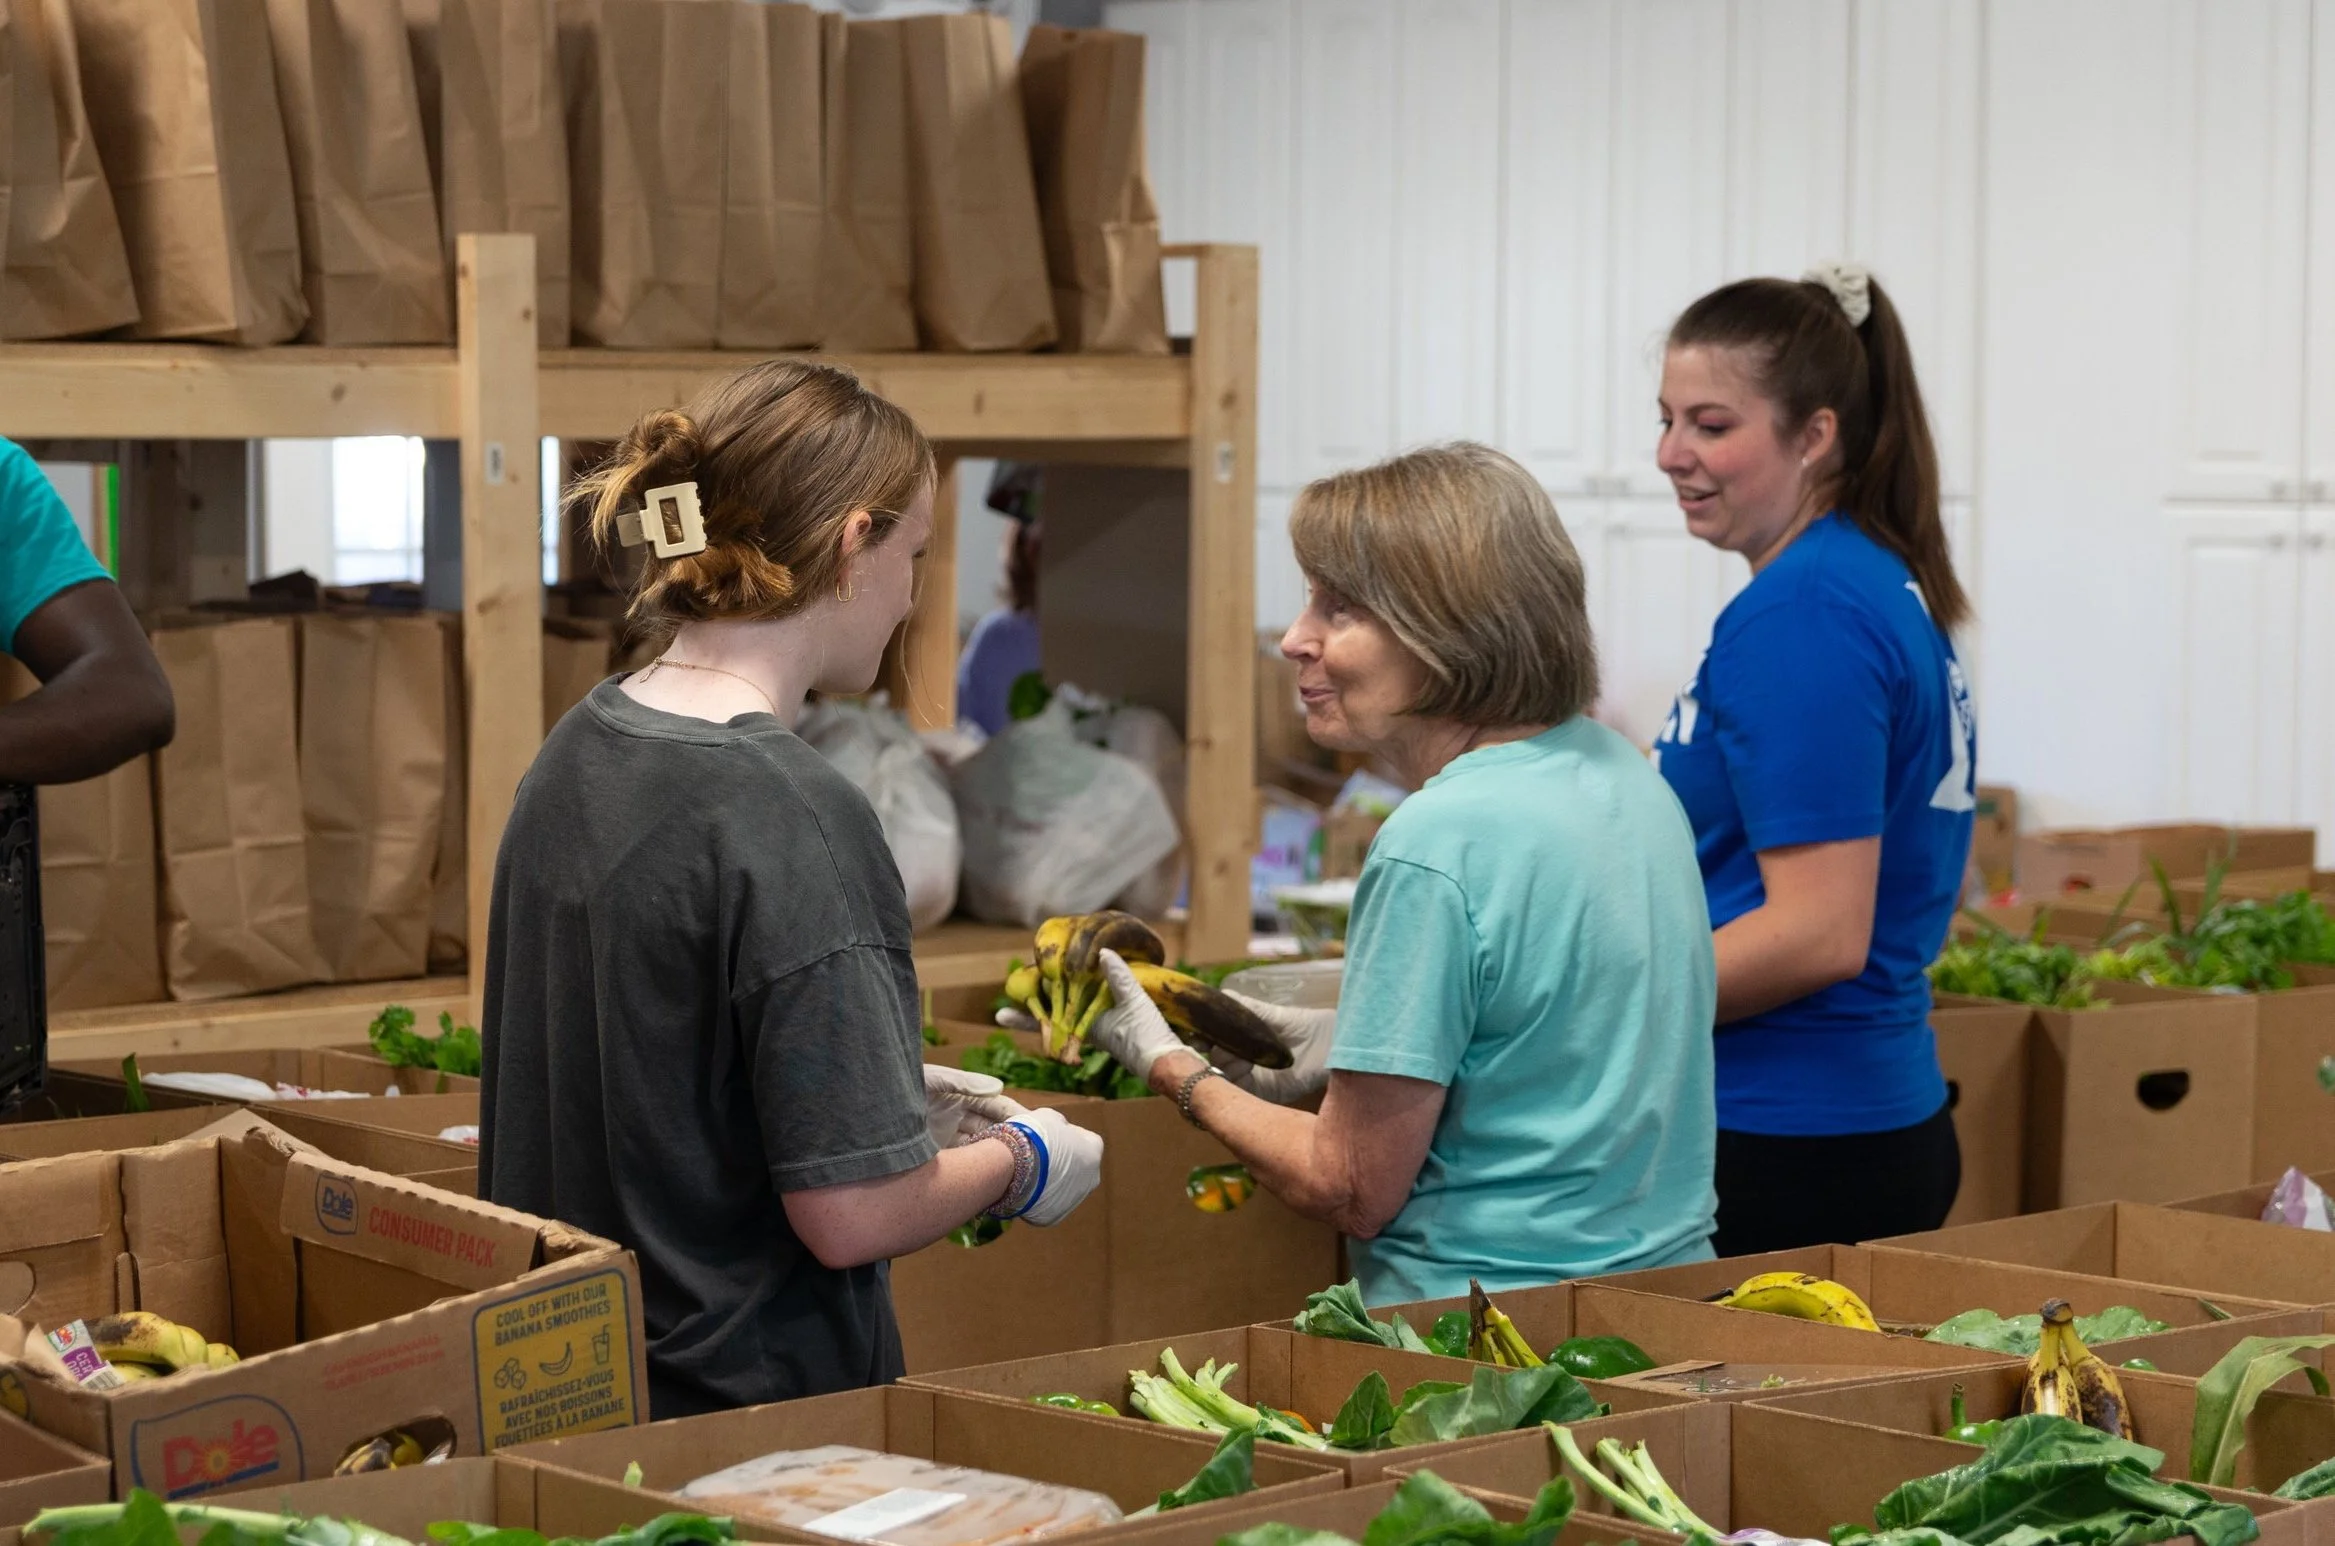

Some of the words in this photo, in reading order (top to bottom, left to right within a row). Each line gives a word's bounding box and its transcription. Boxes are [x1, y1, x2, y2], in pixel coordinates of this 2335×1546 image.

[321, 1186, 354, 1216] Dole
[368, 1206, 450, 1256] CONSUMER
[455, 1232, 496, 1268] PACK
[495, 1321, 543, 1346] BANANA
[545, 1300, 611, 1330] SMOOTHIES
[496, 1309, 525, 1327] COOL
[528, 1301, 548, 1318] OFF
[551, 1292, 580, 1310] WITH
[583, 1282, 607, 1301] OUR
[505, 1410, 532, 1430] AVEC
[534, 1402, 558, 1420] NOS
[560, 1386, 613, 1413] BOISSONS
[566, 1412, 579, 1427] LA
[581, 1398, 625, 1421] BANANE
[163, 1418, 280, 1490] Dole
